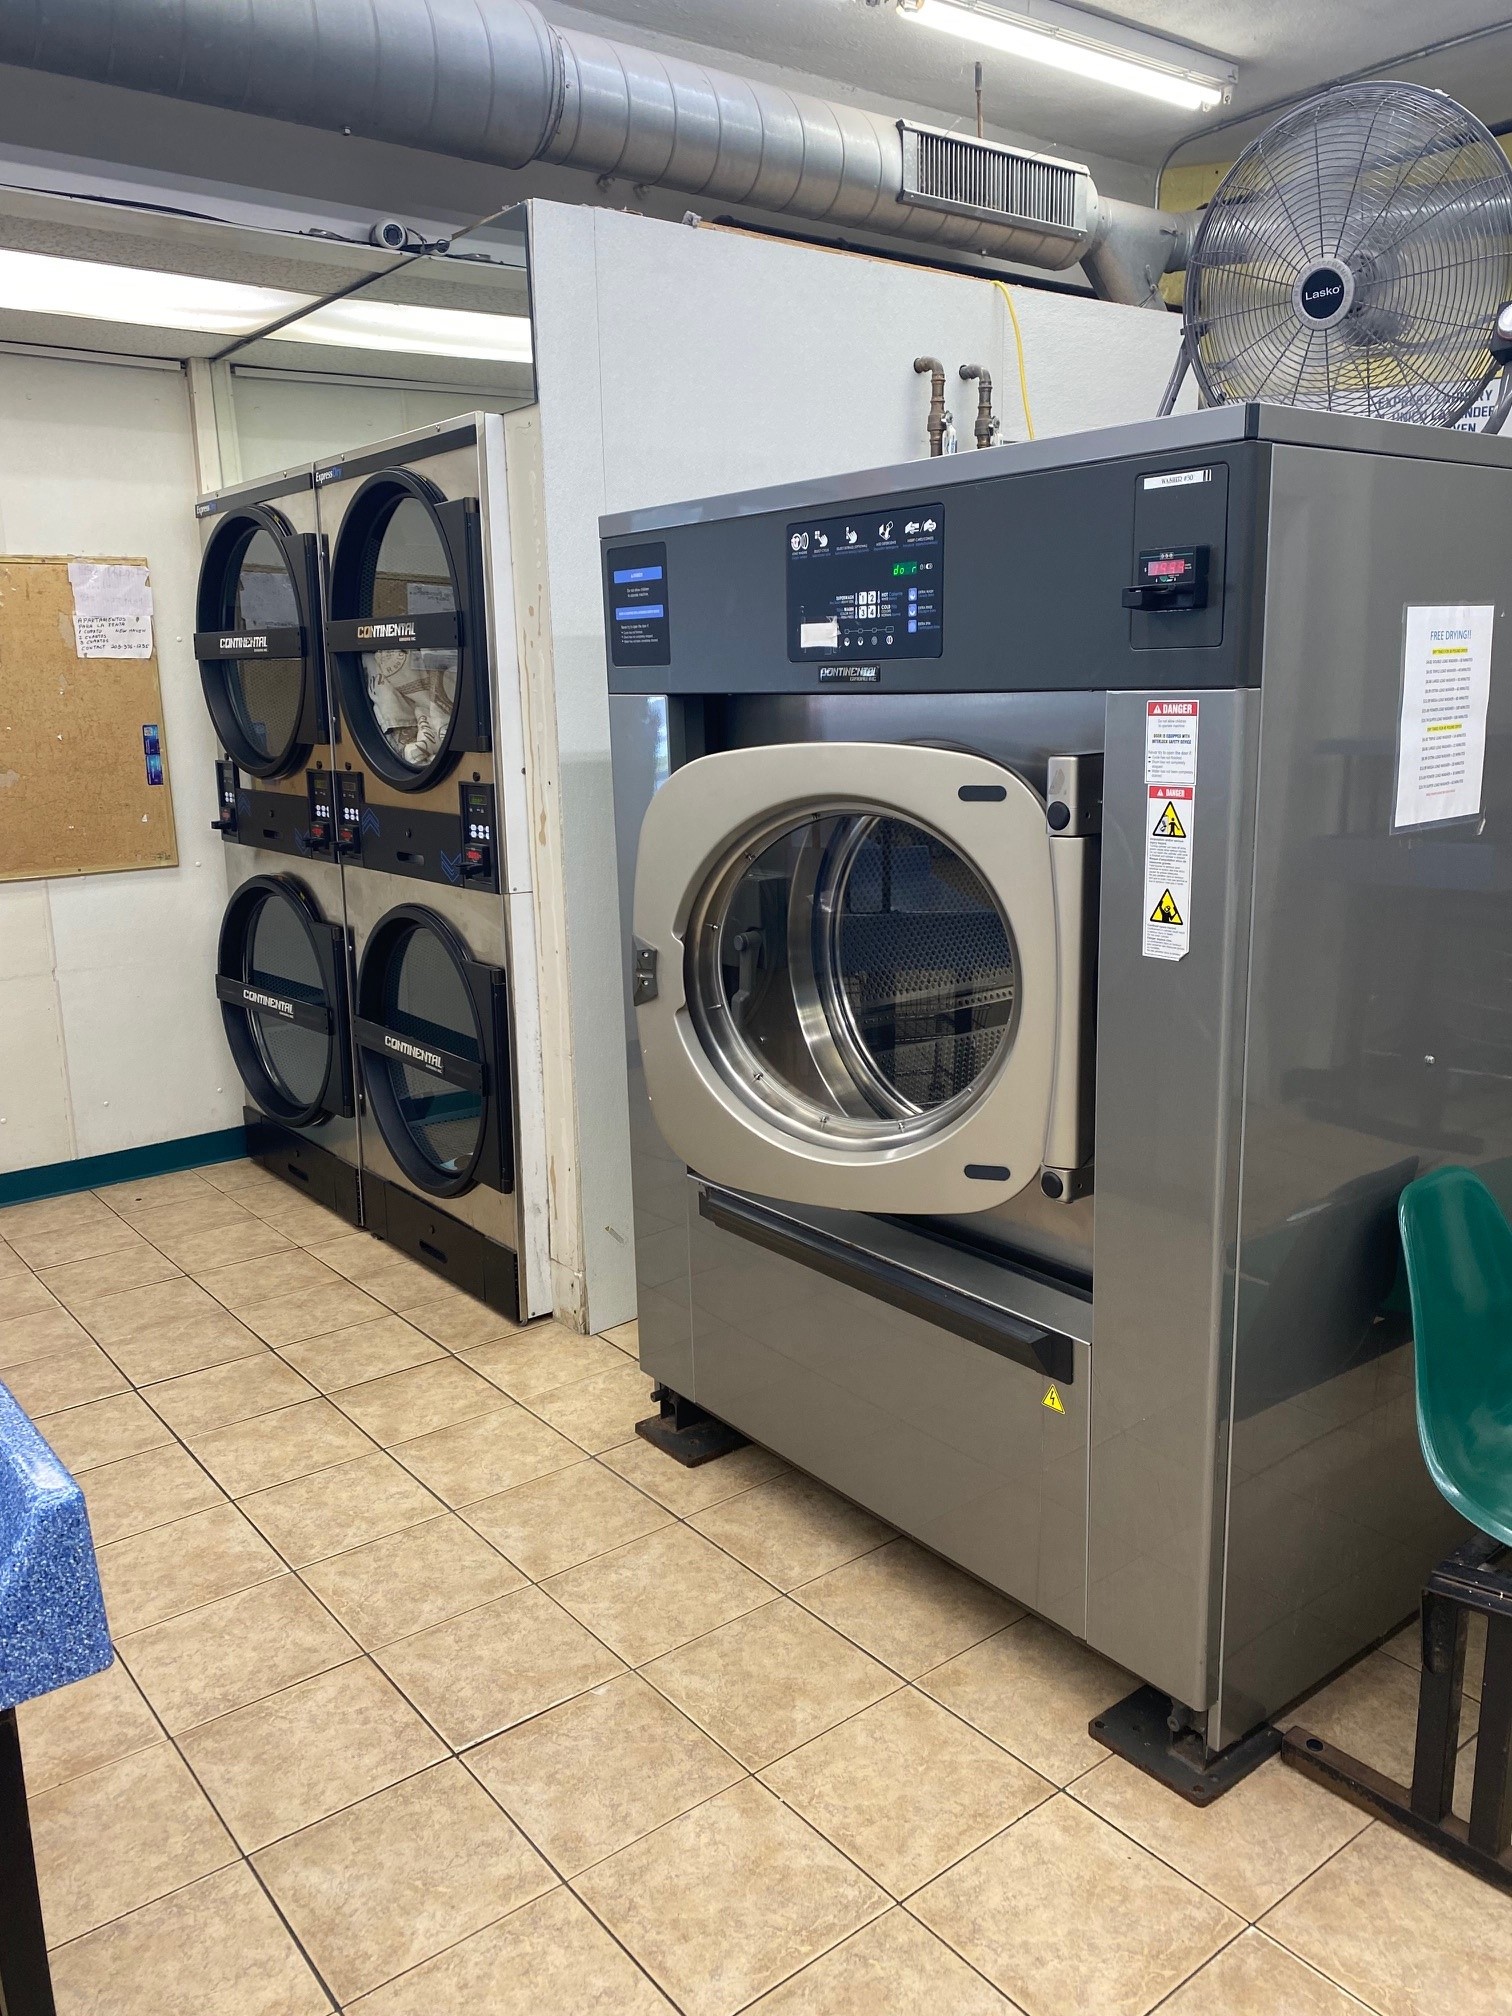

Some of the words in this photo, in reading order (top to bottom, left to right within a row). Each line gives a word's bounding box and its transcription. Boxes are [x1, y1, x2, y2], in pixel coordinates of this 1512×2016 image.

[1305, 286, 1340, 301] Lasko
[357, 622, 416, 639] CONTINENTAL
[1430, 631, 1444, 641] FREE
[1445, 630, 1472, 640] DRYING!!
[219, 636, 268, 649] CONTINENTAL
[1162, 704, 1193, 714] DANGER
[1165, 788, 1185, 797] DANGER
[243, 989, 294, 1015] CONTINENTAL
[384, 1035, 443, 1069] CONTINENTAL
